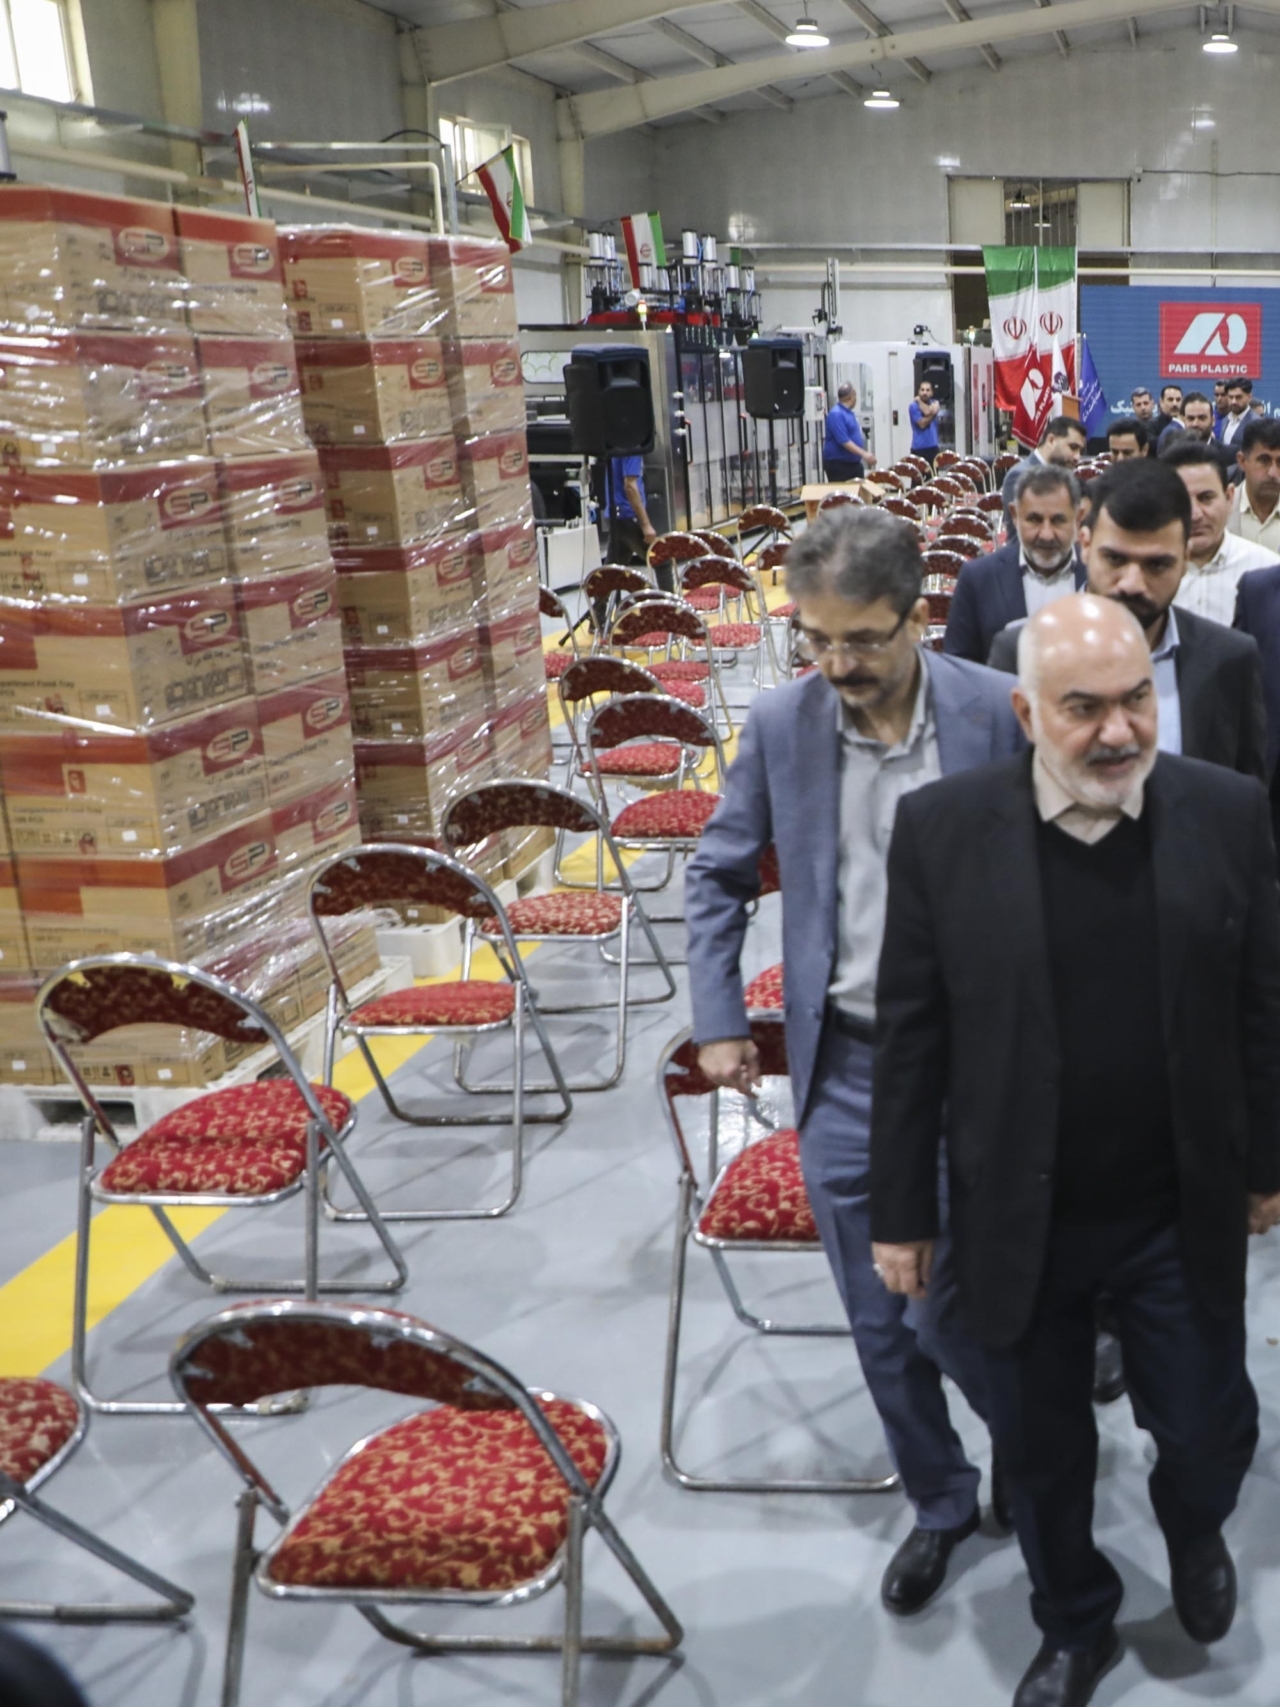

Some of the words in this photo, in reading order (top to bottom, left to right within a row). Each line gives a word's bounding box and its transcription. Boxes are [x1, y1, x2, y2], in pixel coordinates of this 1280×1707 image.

[1168, 363, 1198, 374] PARS
[1200, 363, 1248, 374] PLASTIC
[169, 491, 209, 516] SP
[210, 728, 251, 760] SP
[228, 843, 266, 878] SP
